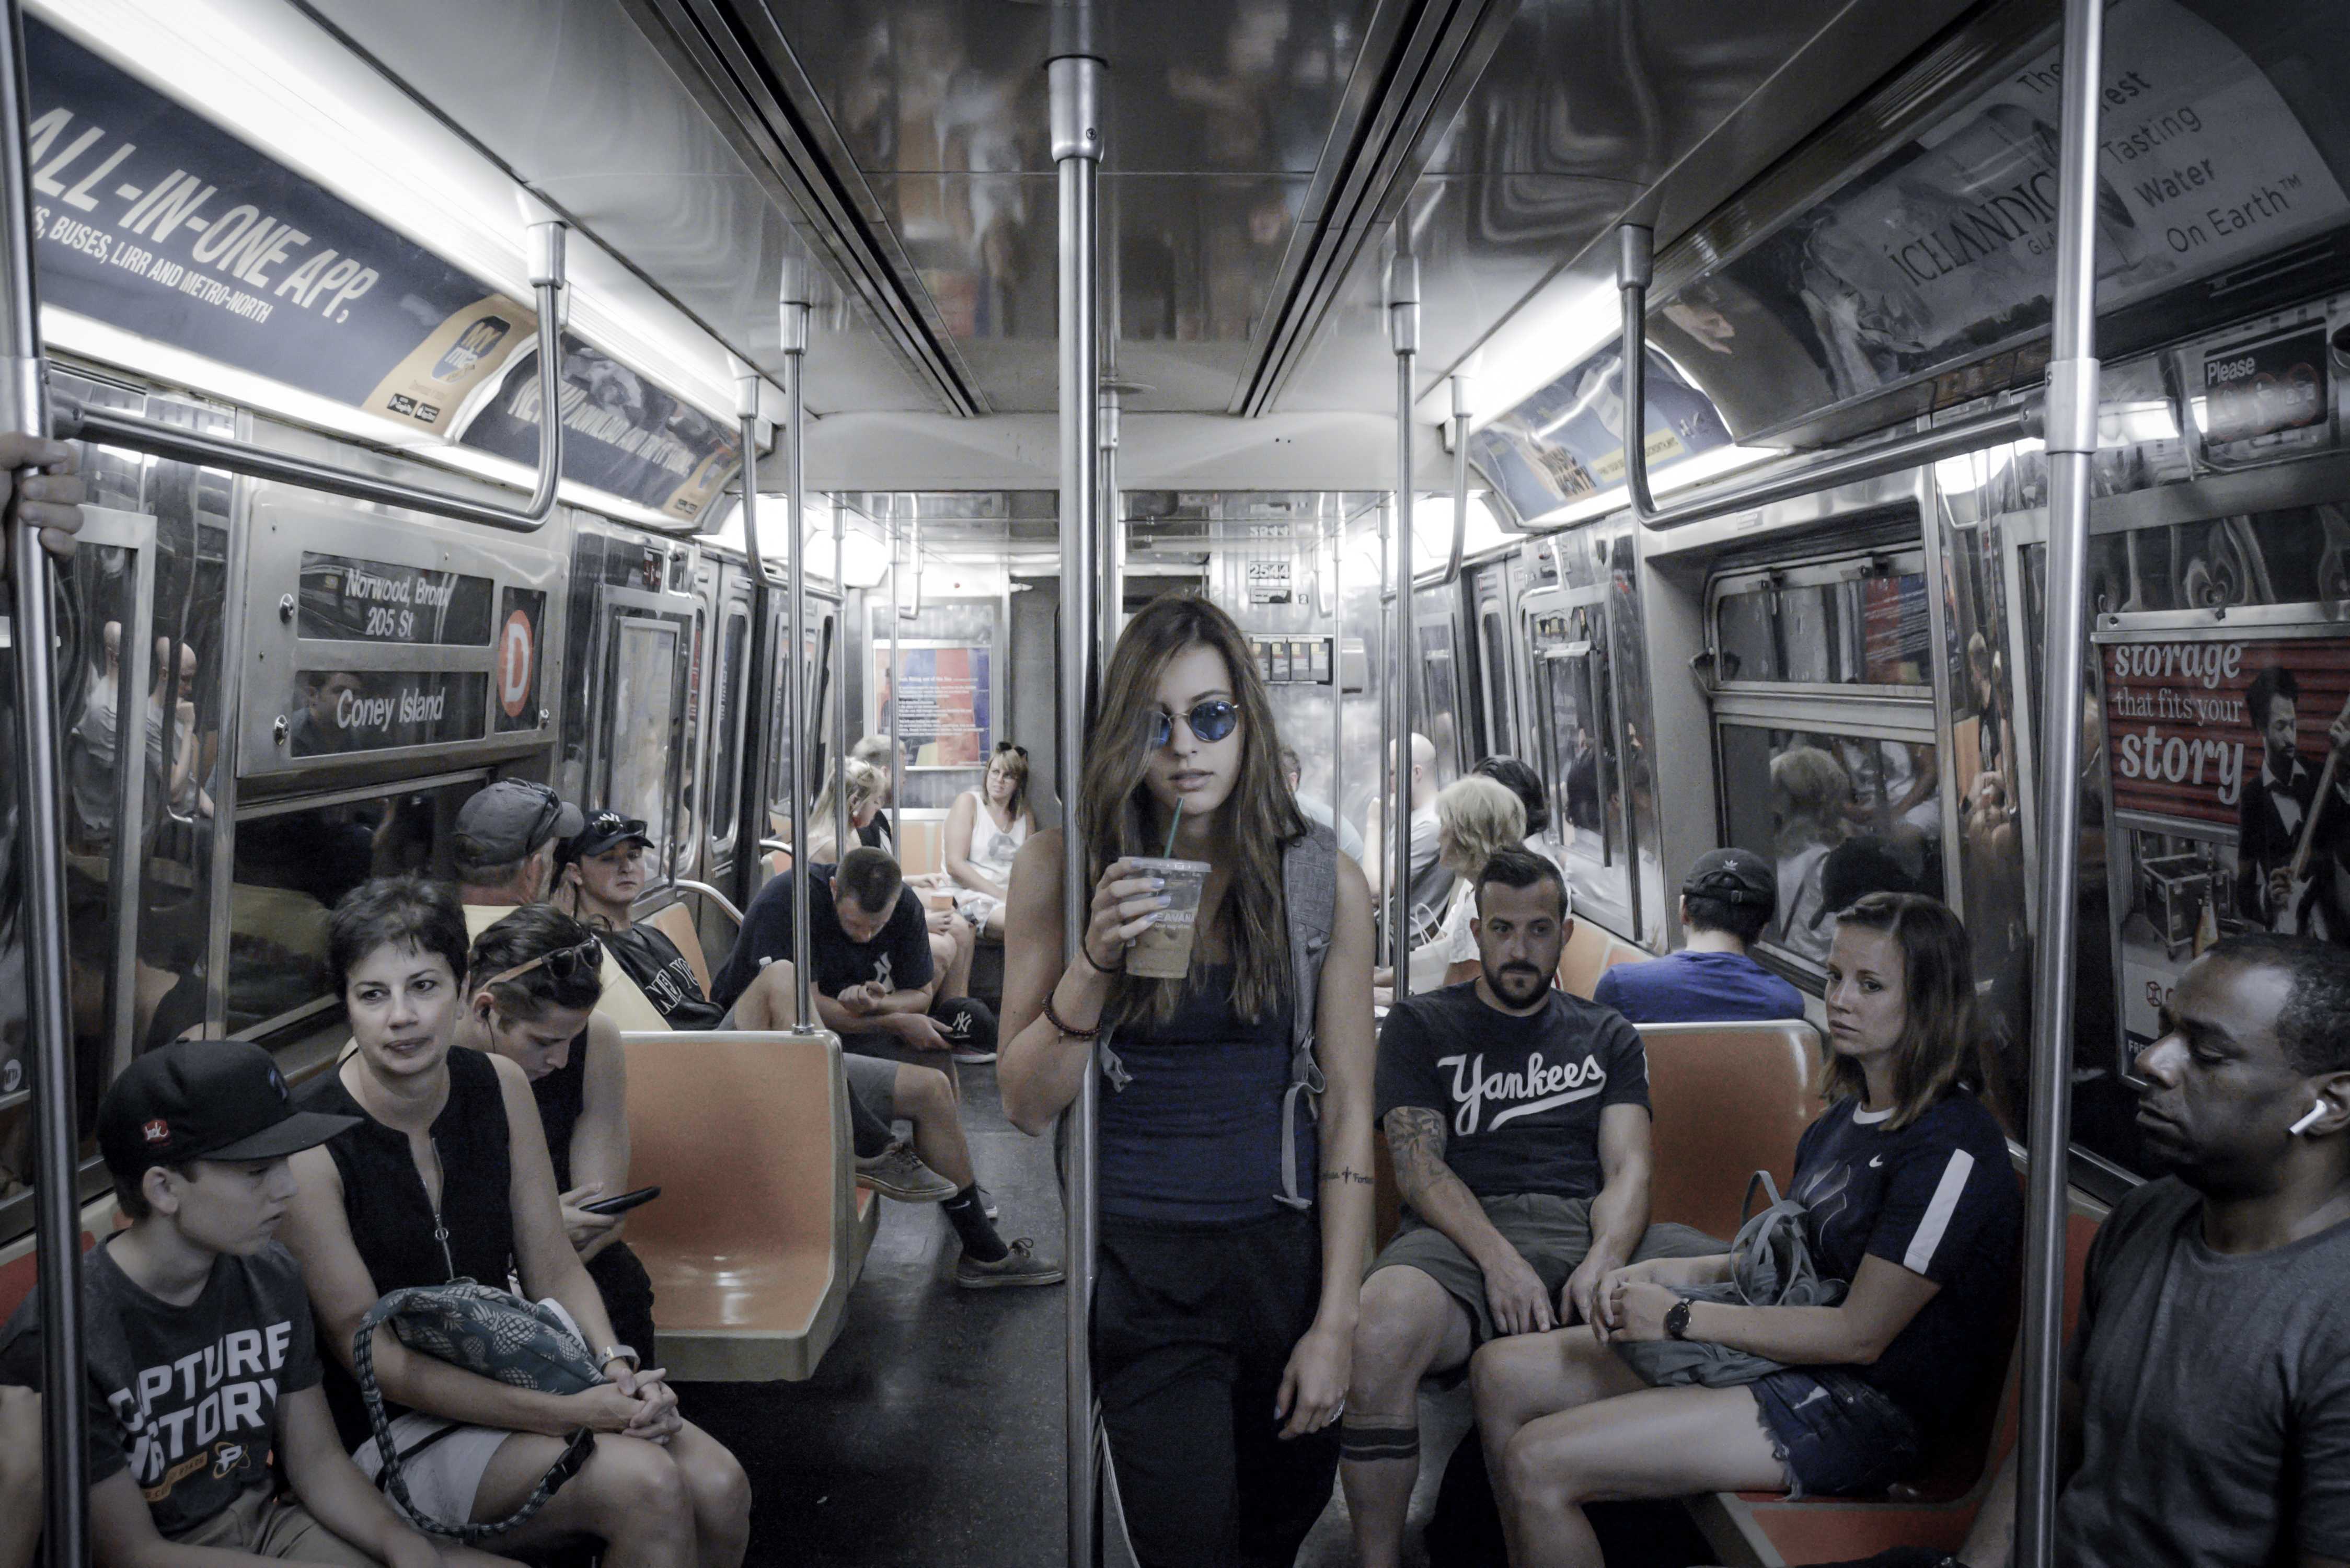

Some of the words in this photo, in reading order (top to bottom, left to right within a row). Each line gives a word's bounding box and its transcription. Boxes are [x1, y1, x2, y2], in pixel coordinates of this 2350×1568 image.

[2017, 62, 2063, 94] The
[2100, 69, 2151, 112] est
[2100, 103, 2202, 165] Tasting
[2135, 157, 2215, 209] Water
[2167, 225, 2207, 253] On
[49, 216, 112, 264] BUSES,
[112, 241, 151, 275] LIRR
[147, 258, 185, 287] AND
[180, 270, 274, 324] METRO-NORTH
[275, 248, 379, 324] APP,
[2207, 356, 2255, 385] Please
[345, 568, 411, 606] Norwood,
[416, 578, 453, 607] Bronx
[1250, 564, 1289, 579] 2544
[366, 607, 395, 636] 205
[398, 609, 414, 637] St
[505, 623, 529, 703] D
[2114, 643, 2242, 689] storage
[337, 689, 395, 732] Coney
[399, 687, 445, 721] Island
[2112, 687, 2153, 718] that
[2158, 688, 2192, 720] fits
[2198, 697, 2243, 727] your
[2119, 726, 2244, 805] story
[1437, 1052, 1606, 1136] Yankees
[108, 1321, 292, 1432] CPTURE
